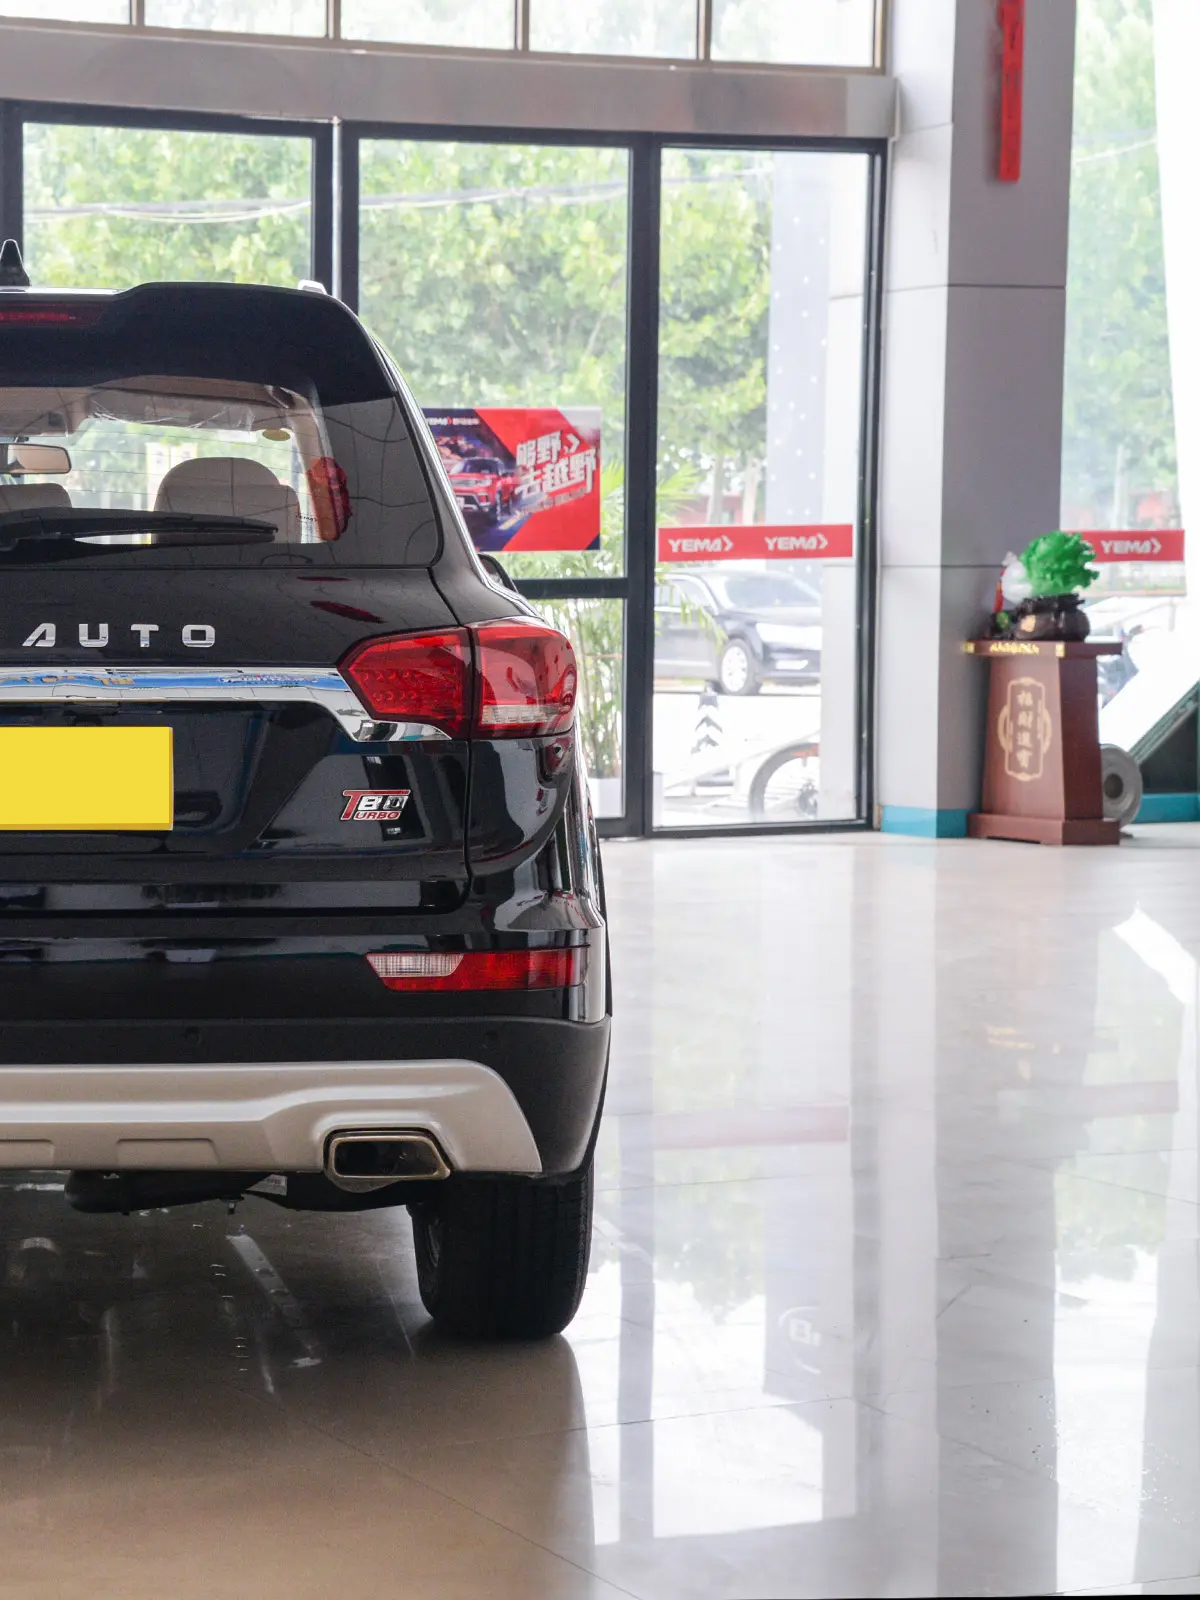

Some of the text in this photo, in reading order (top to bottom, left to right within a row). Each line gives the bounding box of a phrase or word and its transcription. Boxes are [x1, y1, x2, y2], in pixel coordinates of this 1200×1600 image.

[668, 537, 723, 553] YEMA
[764, 535, 818, 551] YEMA
[1100, 539, 1152, 554] YEMA
